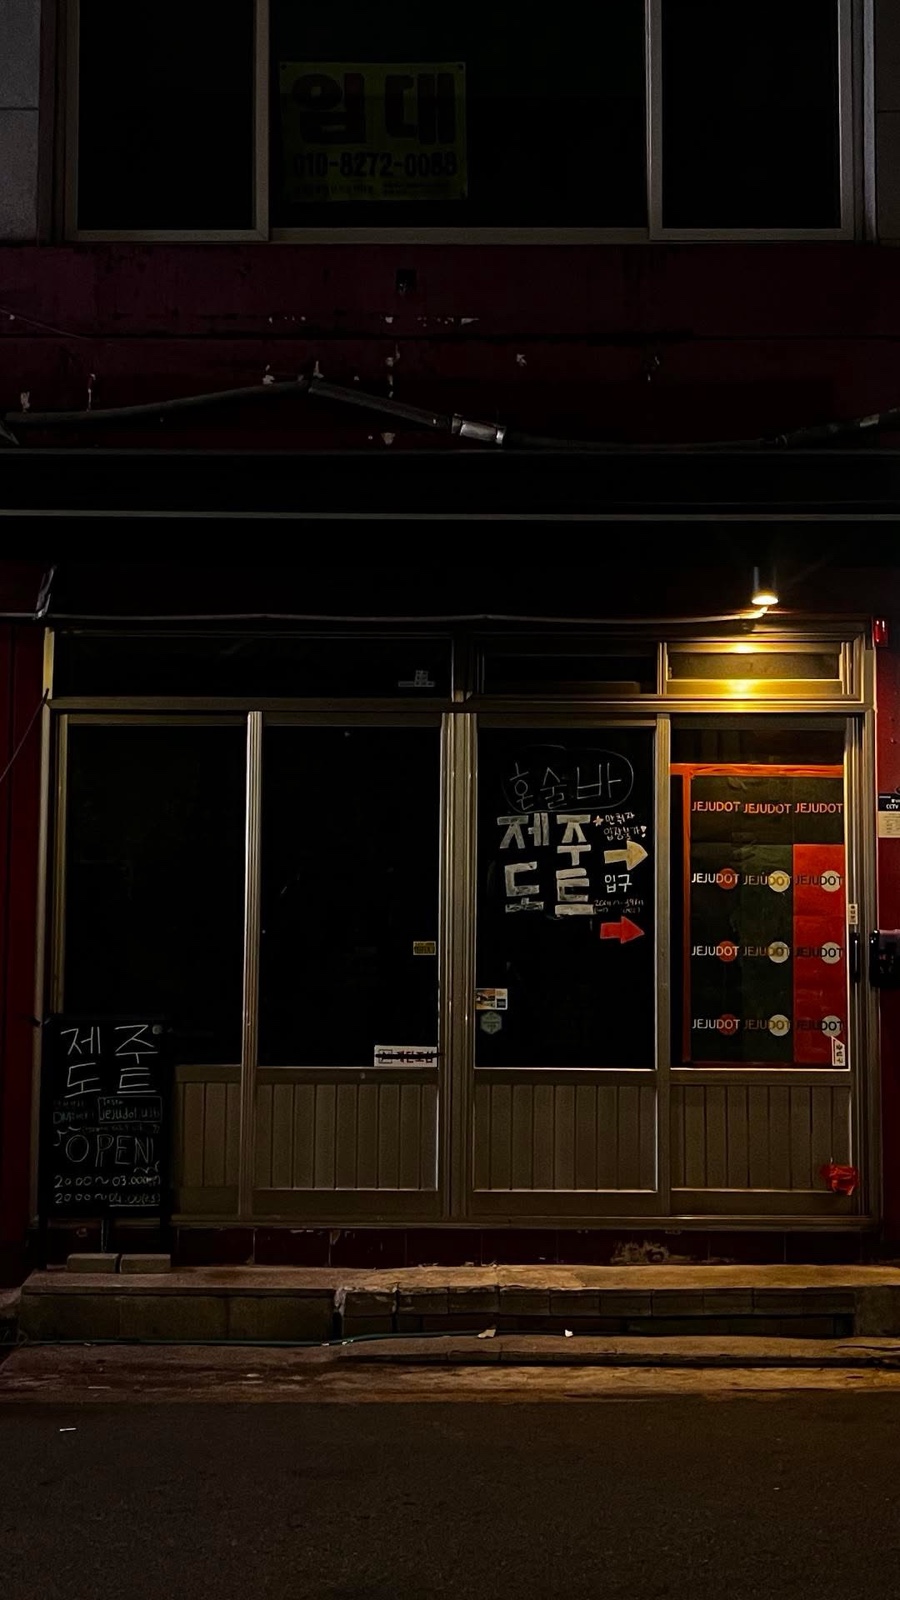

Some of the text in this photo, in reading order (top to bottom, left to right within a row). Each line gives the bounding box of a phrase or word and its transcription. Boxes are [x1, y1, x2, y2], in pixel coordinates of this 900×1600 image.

[292, 73, 456, 144] 임대
[509, 760, 622, 810] 혼술바
[692, 801, 844, 815] JEJUDOT JEJUDOT JEJUDOT
[604, 874, 632, 893] 입구
[691, 872, 843, 887] JEJUDOT JEJUDOT JEJUDOT
[691, 944, 843, 959] JEJUDOT JEJUDOT JEJUDOT
[692, 1017, 844, 1032] JEJUDOT JEJUDOT JEJUDOT
[60, 1024, 159, 1064] 제주
[65, 1062, 157, 1098] 도트
